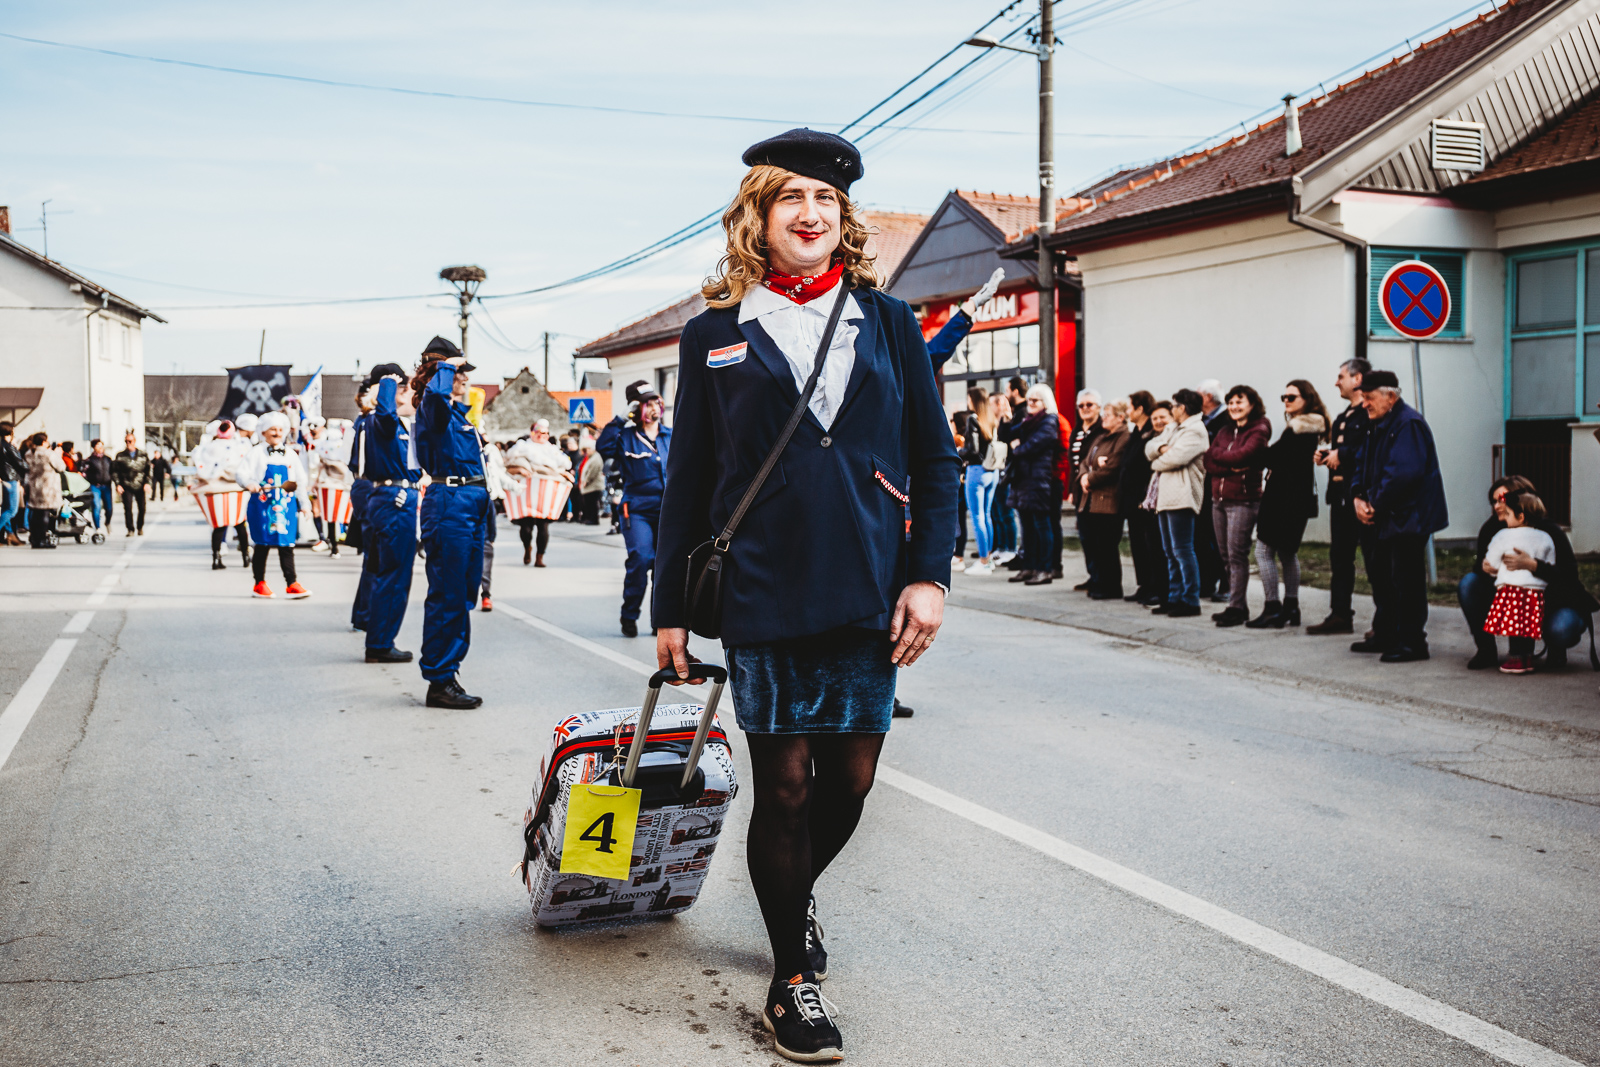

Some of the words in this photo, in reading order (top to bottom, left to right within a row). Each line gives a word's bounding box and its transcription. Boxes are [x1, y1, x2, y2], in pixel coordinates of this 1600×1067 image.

[651, 812, 663, 828] CITY
[579, 812, 617, 854] 4
[649, 829, 659, 838] OF
[642, 839, 656, 865] LONDON
[614, 889, 659, 901] LONDON
